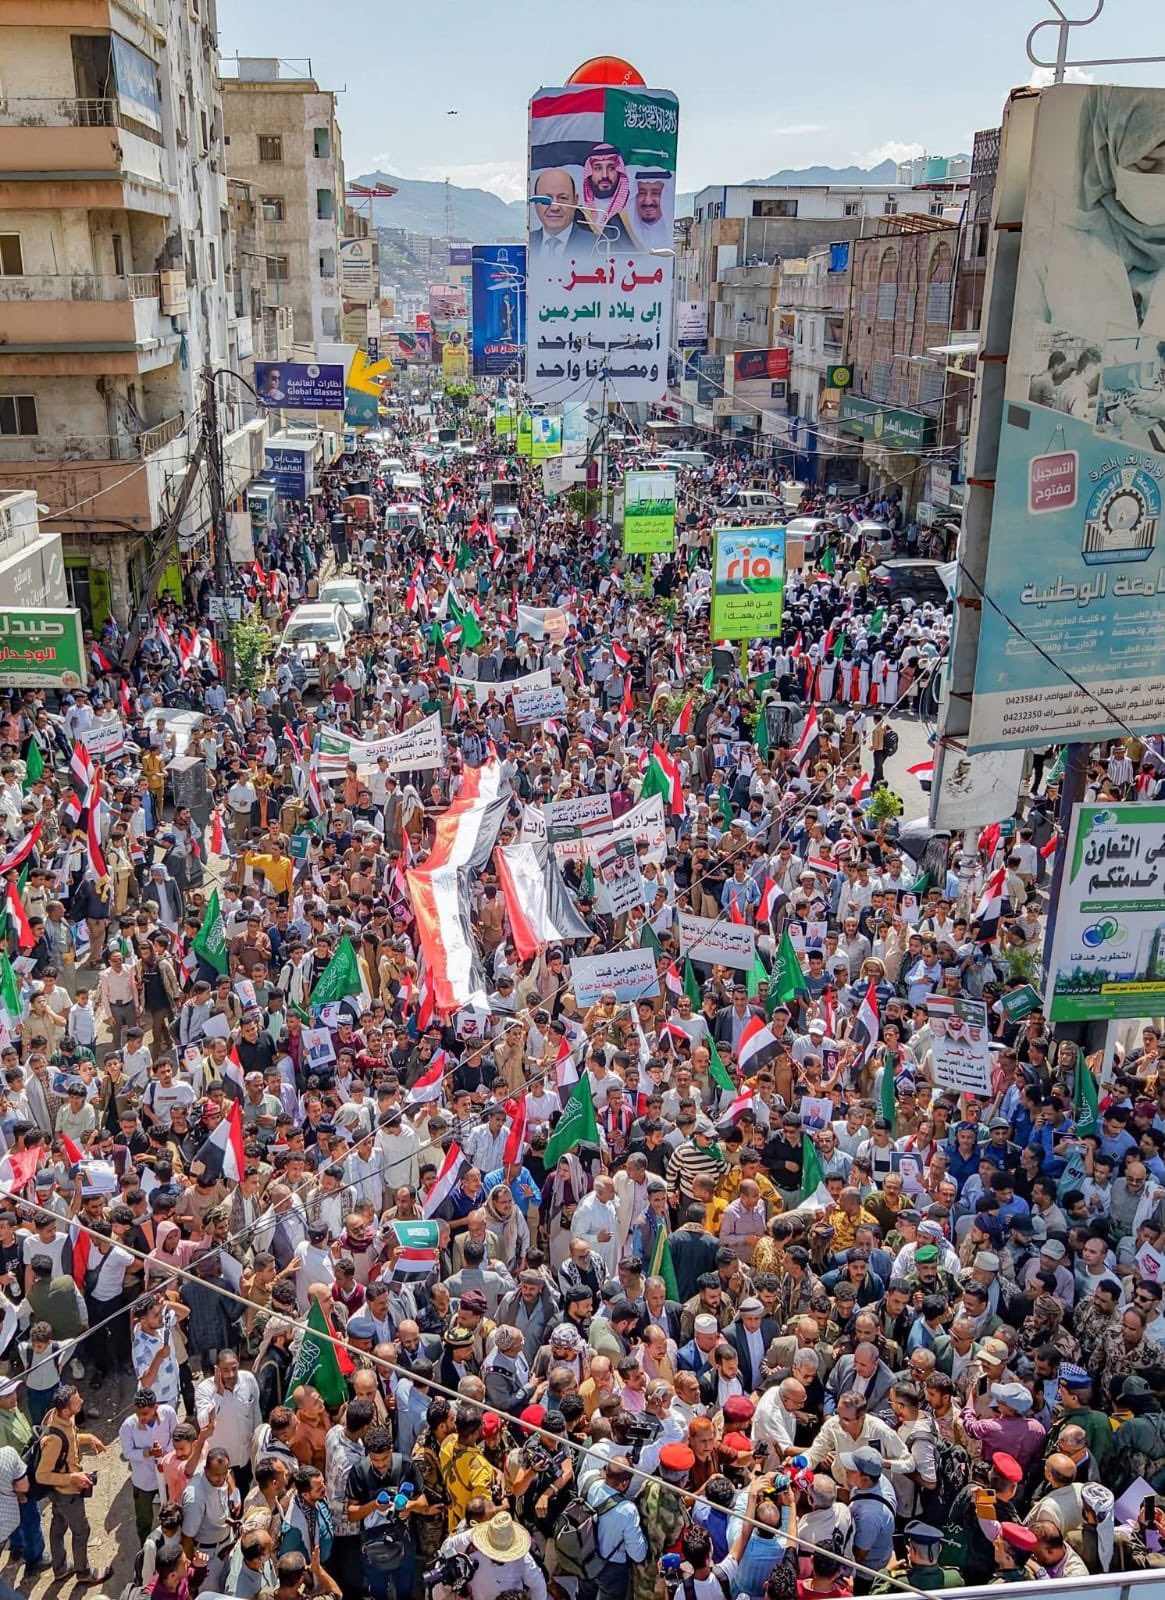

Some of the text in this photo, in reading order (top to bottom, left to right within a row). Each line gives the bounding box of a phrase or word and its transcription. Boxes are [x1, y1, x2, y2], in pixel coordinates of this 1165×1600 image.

[621, 260, 663, 292] من
[539, 301, 662, 324] إلى بلاد الحرمين
[538, 332, 582, 353] واحد
[536, 359, 580, 381] واحد
[288, 380, 342, 389] نظارات العالمية
[274, 455, 302, 463] نظارات
[274, 464, 301, 472] العالمية
[1032, 462, 1074, 482] التسجيل
[1035, 483, 1071, 503] مفتوح
[1090, 474, 1120, 517] الوطنية
[1136, 474, 1158, 514] الجامعة
[728, 548, 771, 579] ria
[1020, 567, 1165, 609] امعة الوطنية
[726, 600, 773, 609] من قلبك
[756, 611, 772, 620] لمن
[1006, 693, 1043, 705] 04235843
[1004, 710, 1042, 722] 04232350
[1002, 724, 1040, 736] 04242409
[1085, 834, 1141, 866] التعاون
[1089, 865, 1159, 895] خدمتكم
[1070, 952, 1132, 962] التطوير هدفنا
[614, 964, 640, 977] الحرمين
[641, 962, 652, 971] بلاد
[945, 1048, 984, 1060] من تعز
